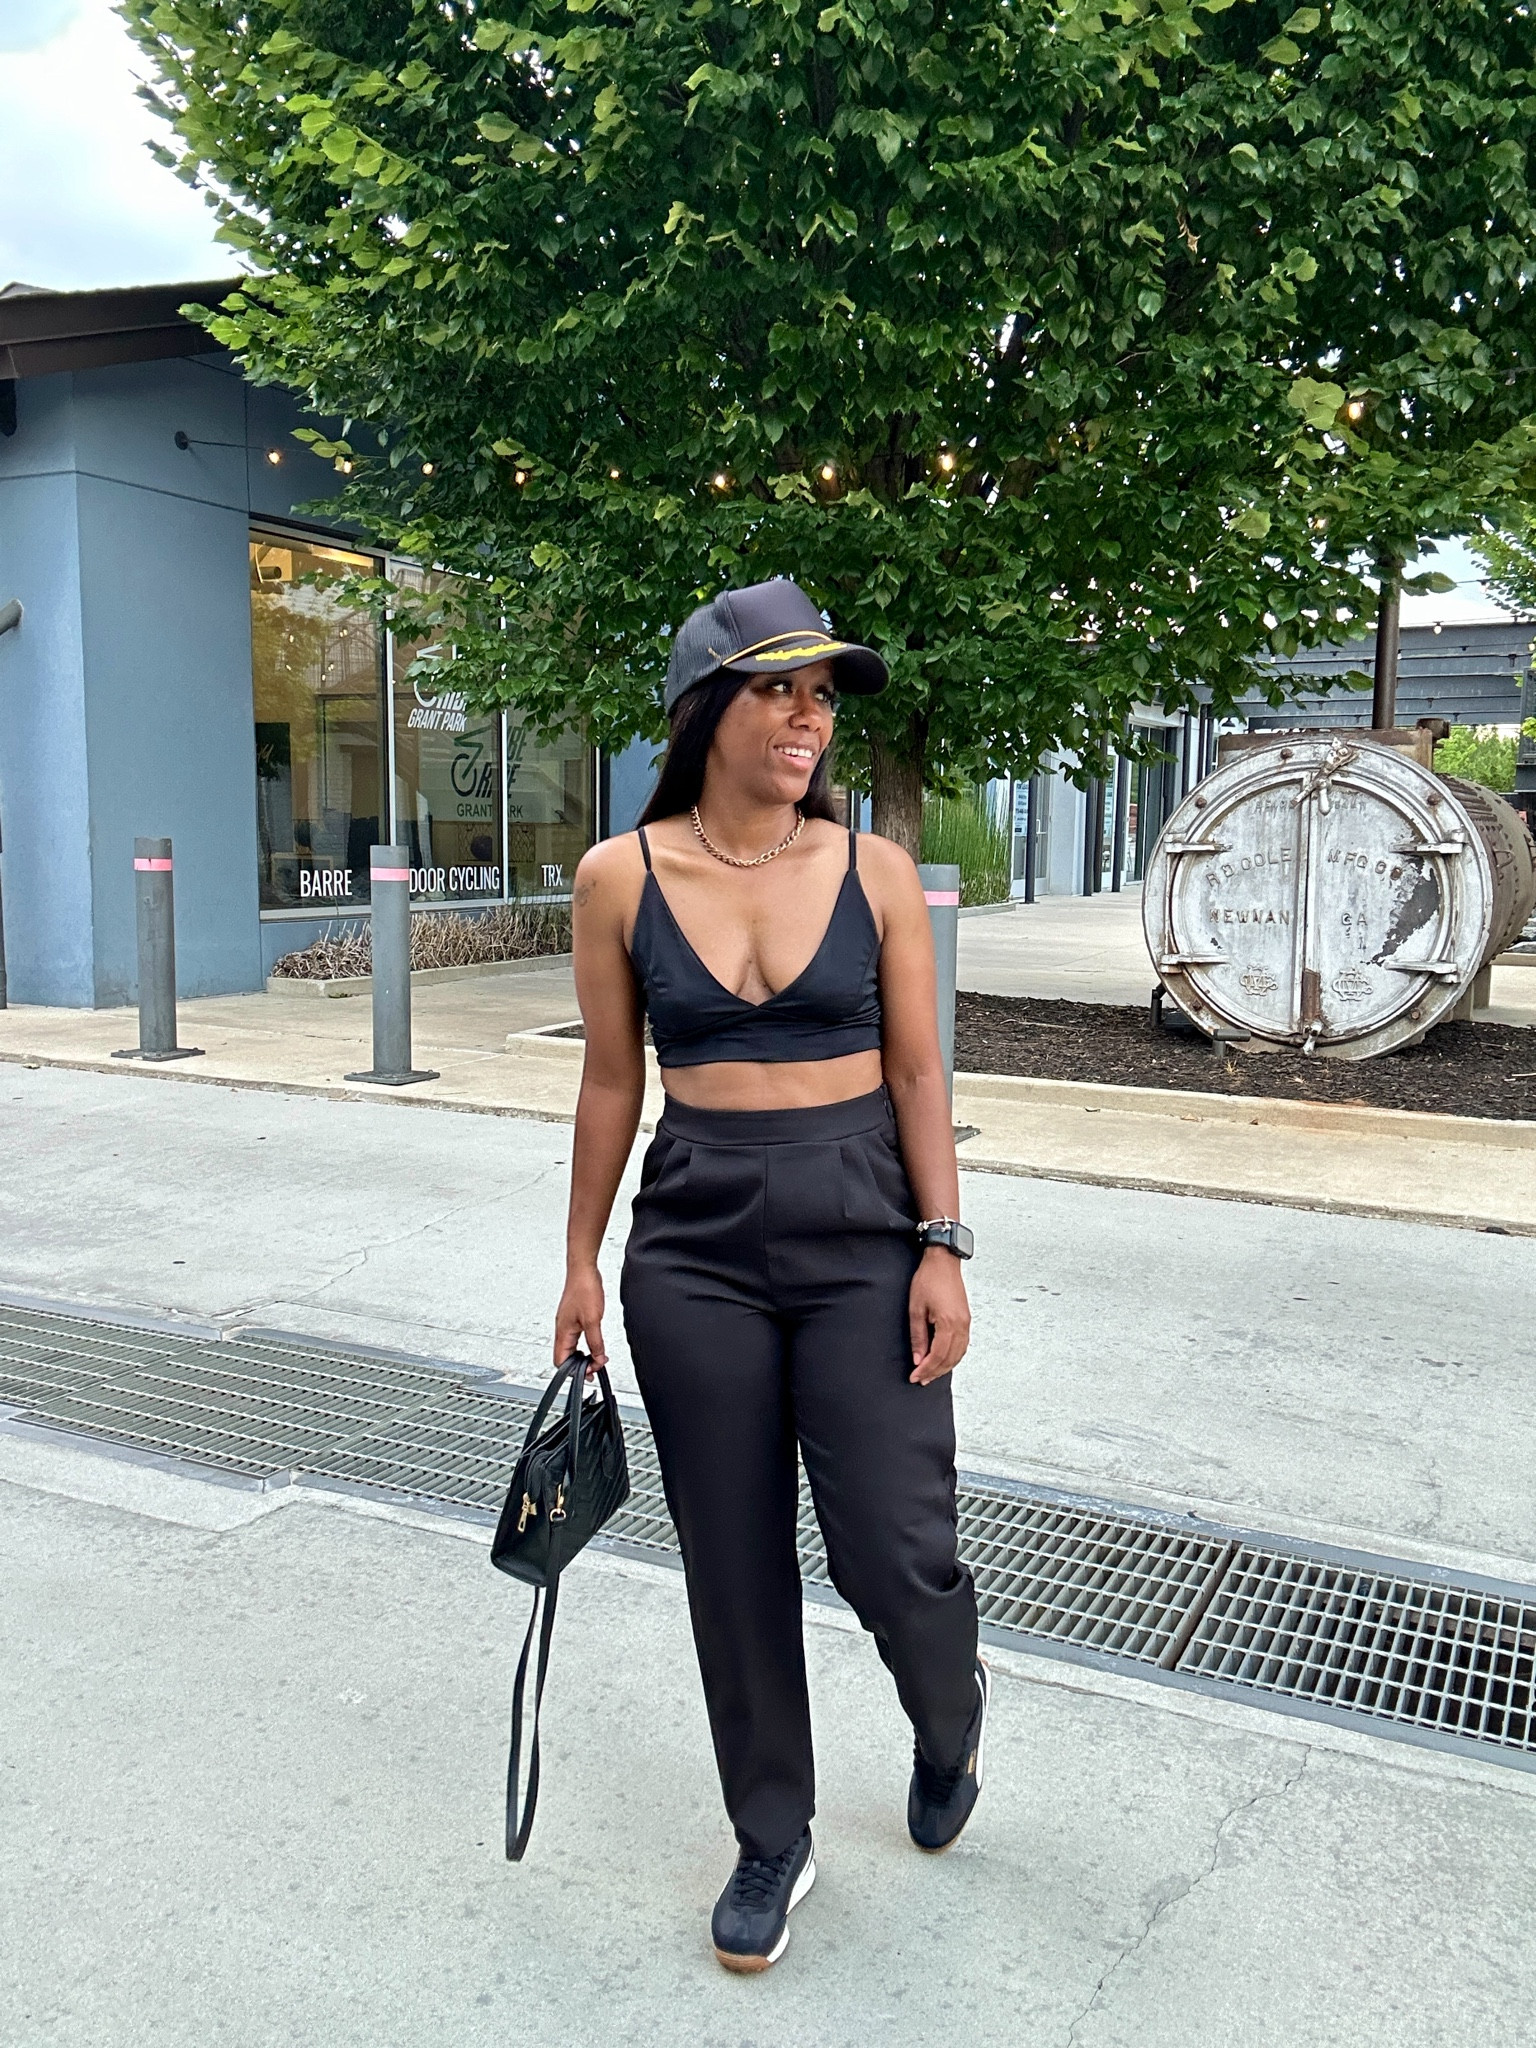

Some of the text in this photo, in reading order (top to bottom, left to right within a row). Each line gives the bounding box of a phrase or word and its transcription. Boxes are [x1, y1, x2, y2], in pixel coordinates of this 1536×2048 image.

[407, 707, 468, 732] GRANT PARK
[475, 761, 521, 799] RE
[456, 803, 524, 819] GRANT RK
[300, 863, 563, 898] BARRE DOOR CYCLING TRX
[1209, 908, 1290, 926] NEWNAN
